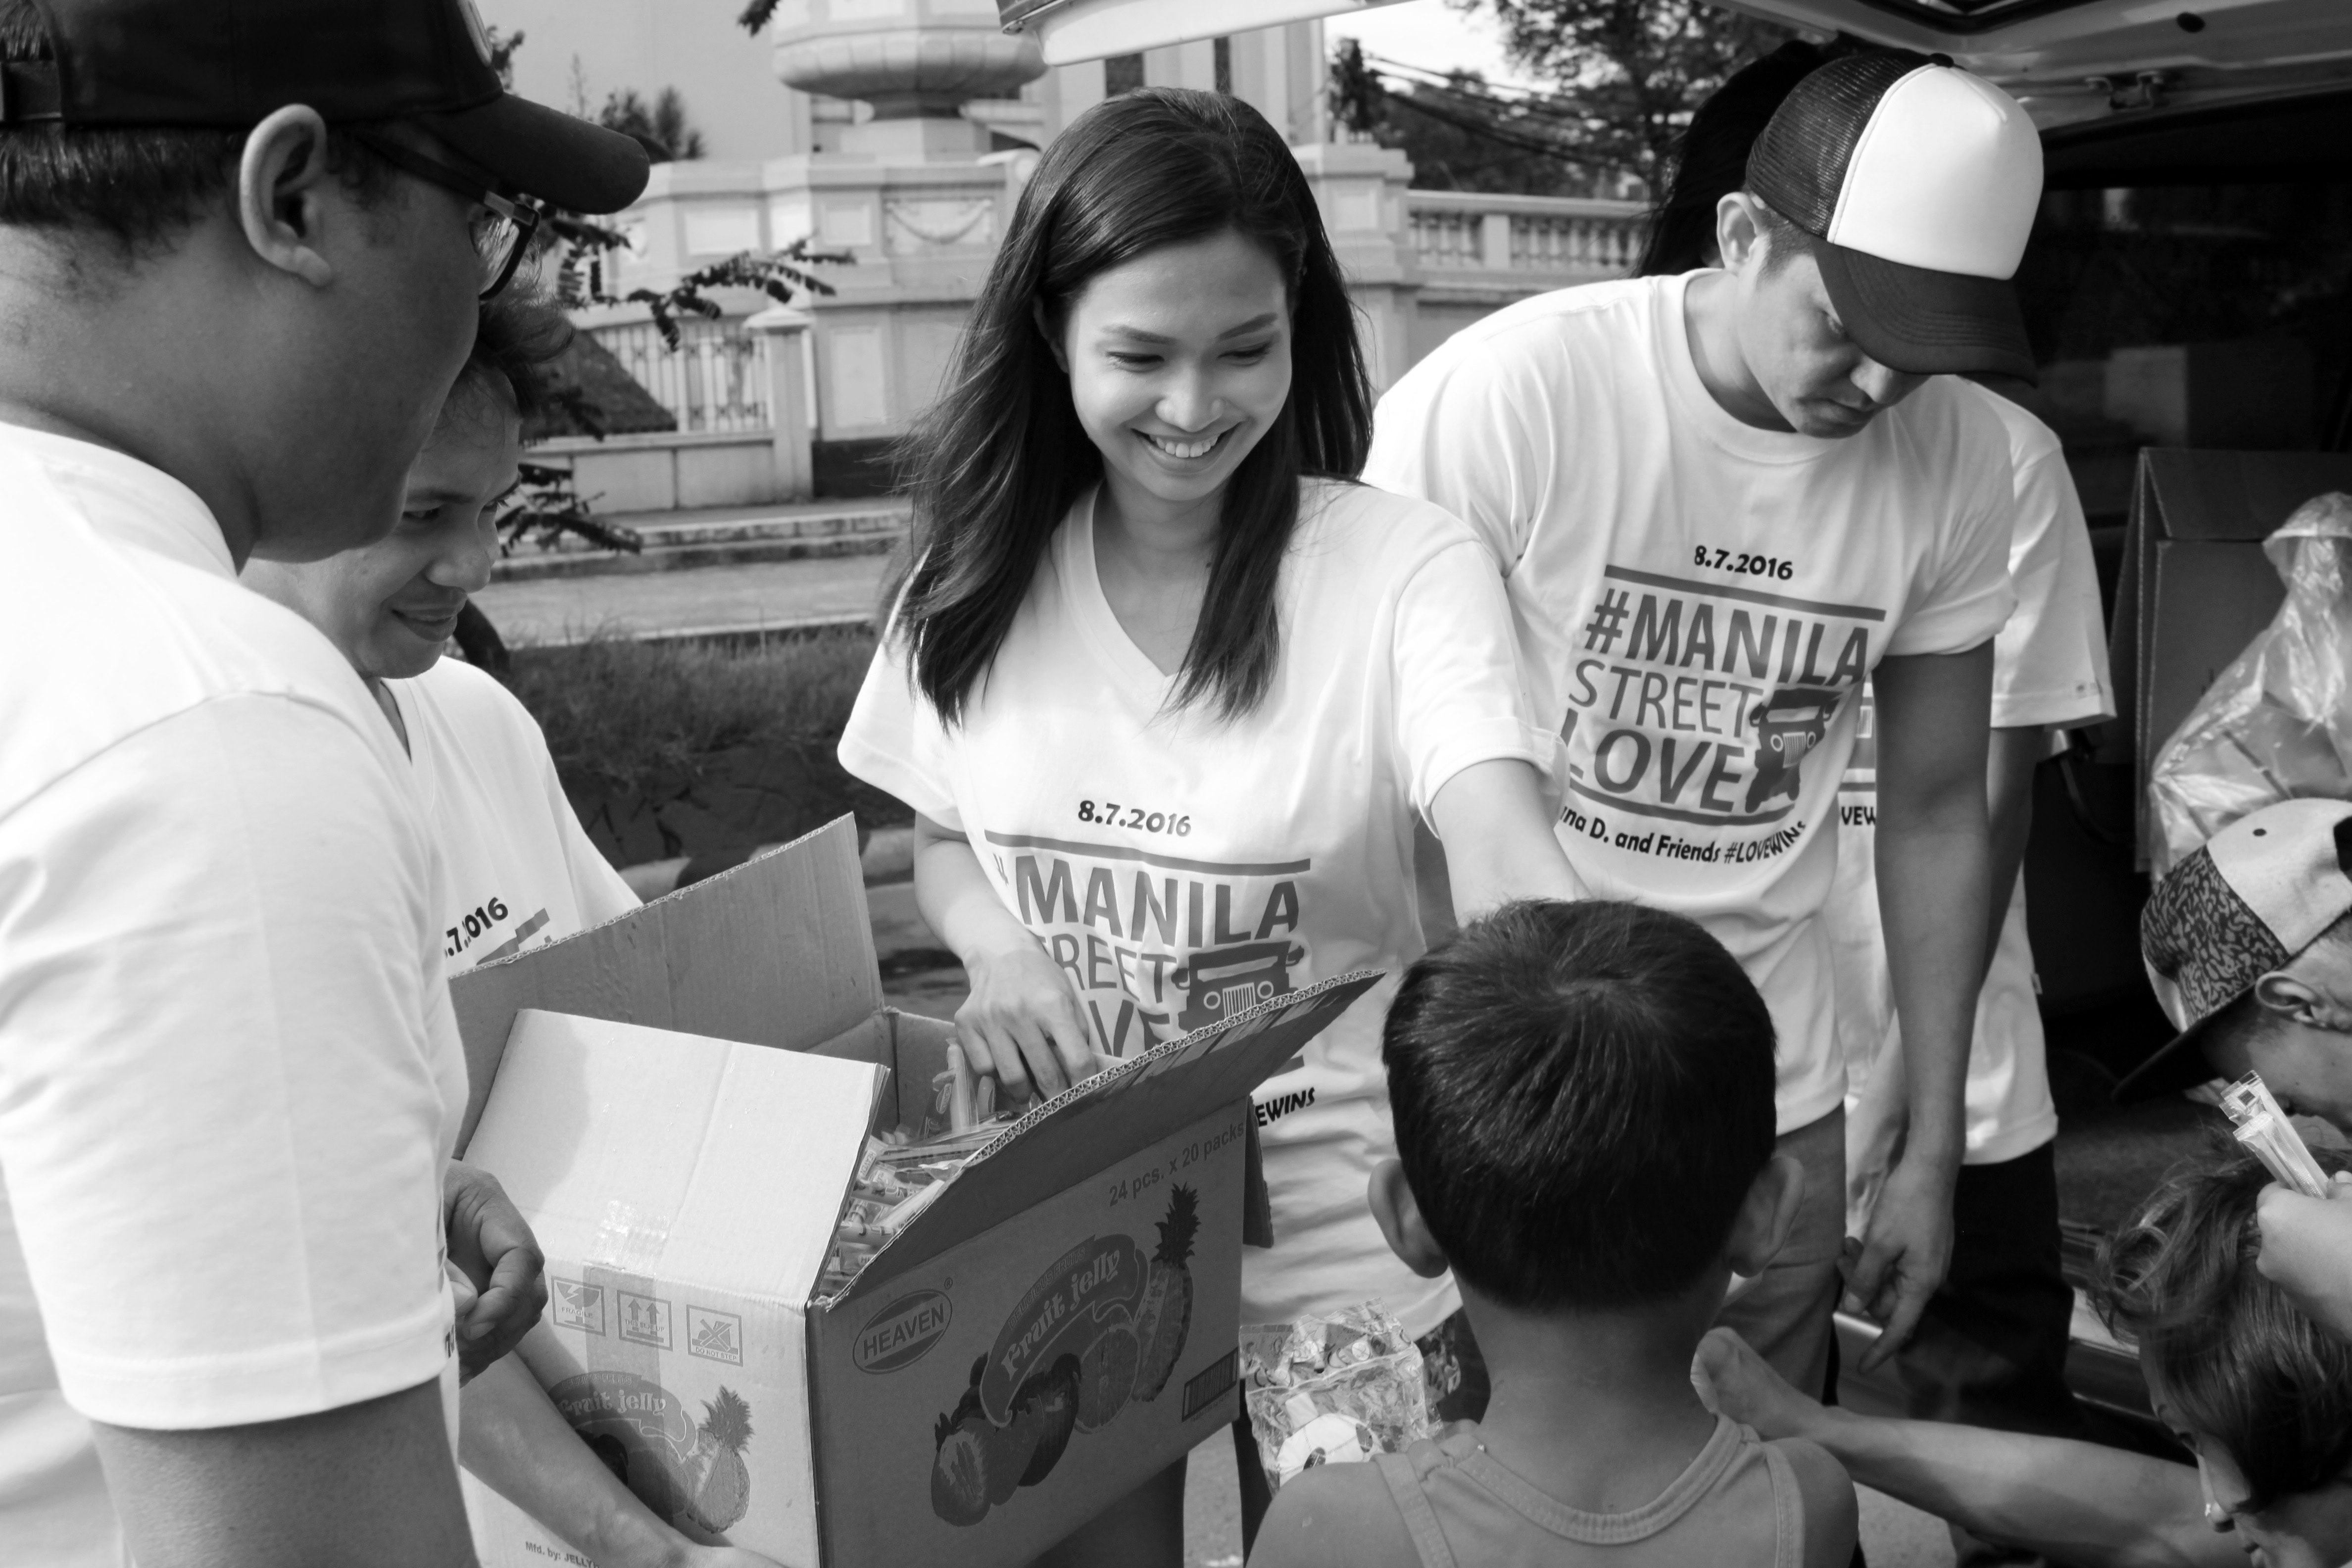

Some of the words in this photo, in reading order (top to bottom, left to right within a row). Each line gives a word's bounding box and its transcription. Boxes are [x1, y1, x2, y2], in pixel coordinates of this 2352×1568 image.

[1694, 545, 1793, 580] 8.7.2016
[1585, 588, 1869, 686] #MANILA
[1568, 659, 1764, 738] STREET
[1078, 800, 1191, 837] 8.7.2016
[1589, 817, 1609, 843] D.
[1615, 832, 1655, 855] and
[1655, 834, 1721, 863] Friends
[1039, 933, 1177, 1004] REET
[1109, 1179, 1128, 1207] 24
[1132, 1168, 1164, 1199] pcs.
[1182, 1142, 1199, 1168] 20
[1203, 1122, 1244, 1161] packs
[1070, 1249, 1120, 1312] jelly
[561, 1307, 593, 1319] FRAGILE
[863, 1303, 944, 1360] HEAVEN
[721, 1352, 736, 1361] STEP
[617, 1389, 667, 1417] jelly
[526, 1541, 545, 1555] Mfd.
[547, 1547, 561, 1562] by:
